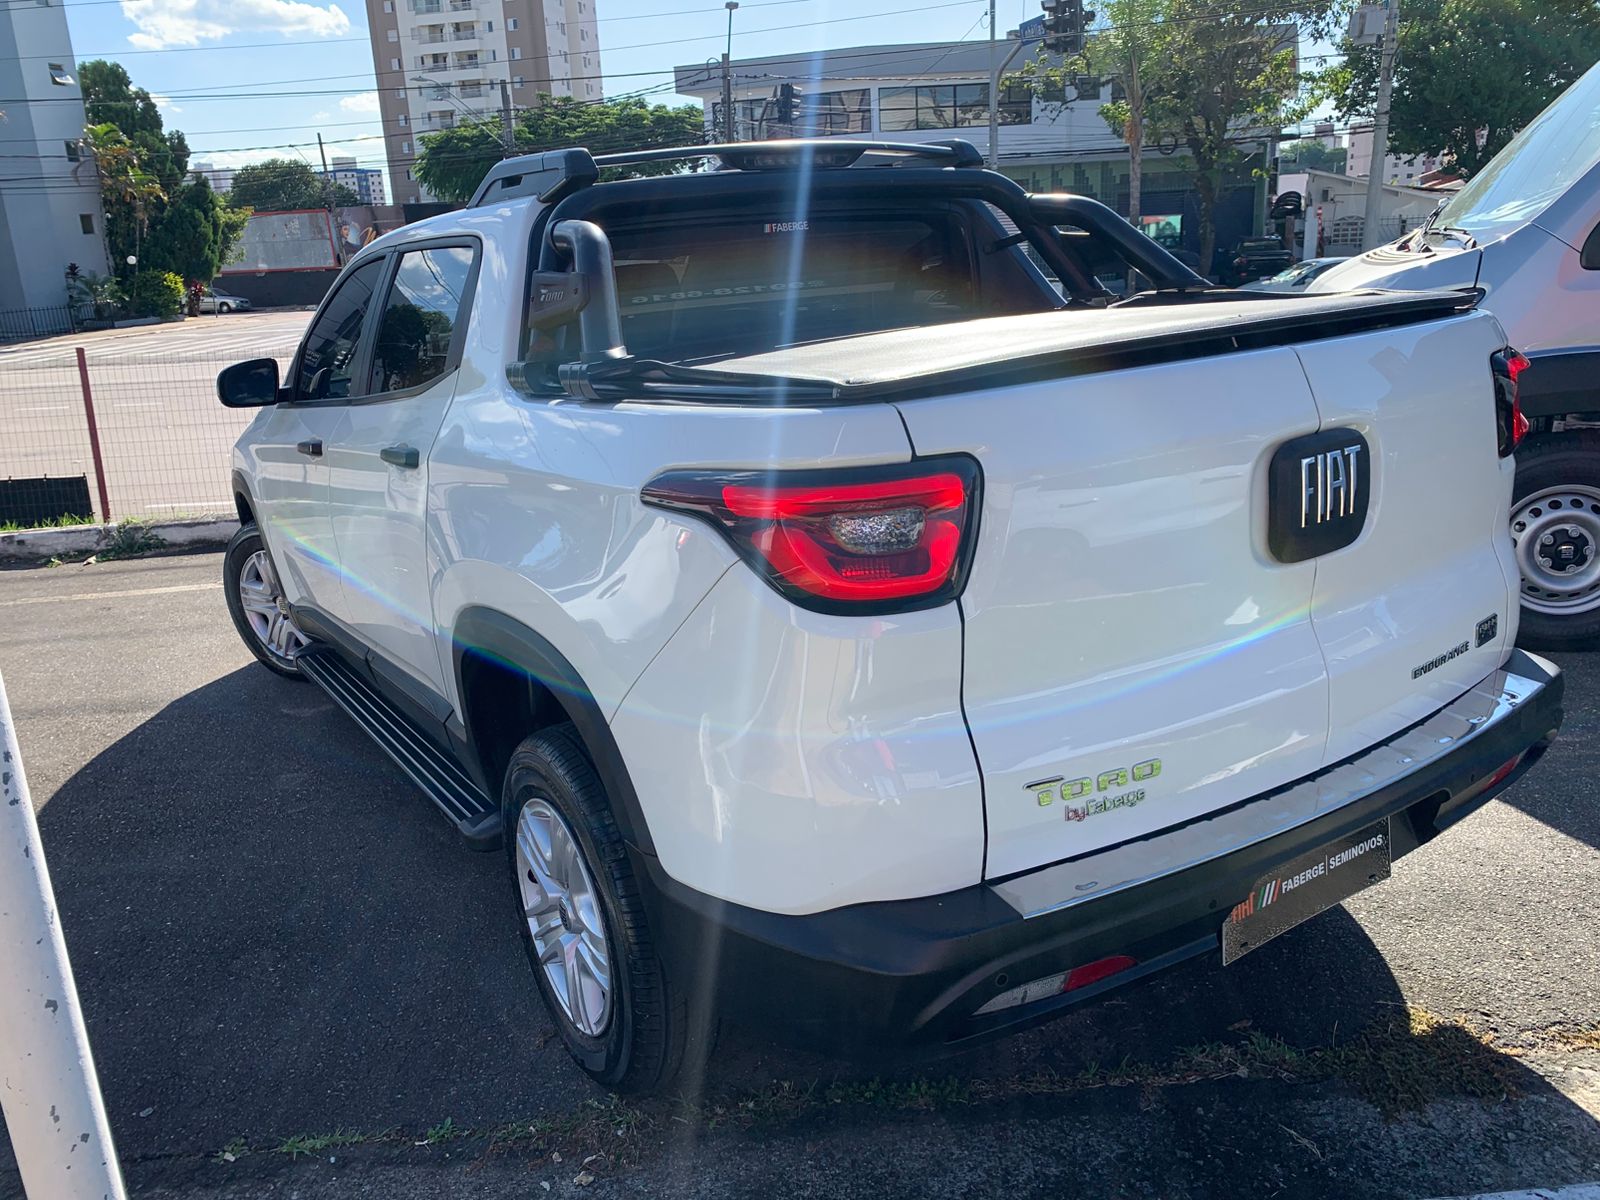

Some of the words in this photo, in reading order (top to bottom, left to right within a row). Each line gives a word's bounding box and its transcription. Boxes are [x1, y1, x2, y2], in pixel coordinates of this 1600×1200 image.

[772, 221, 809, 232] FABERGE
[1301, 444, 1361, 528] FIAT
[1411, 641, 1470, 680] ENDURANCE
[1023, 758, 1162, 807] TORO
[1281, 862, 1325, 894] FABERGE
[1329, 834, 1384, 870] SEMINOVOS
